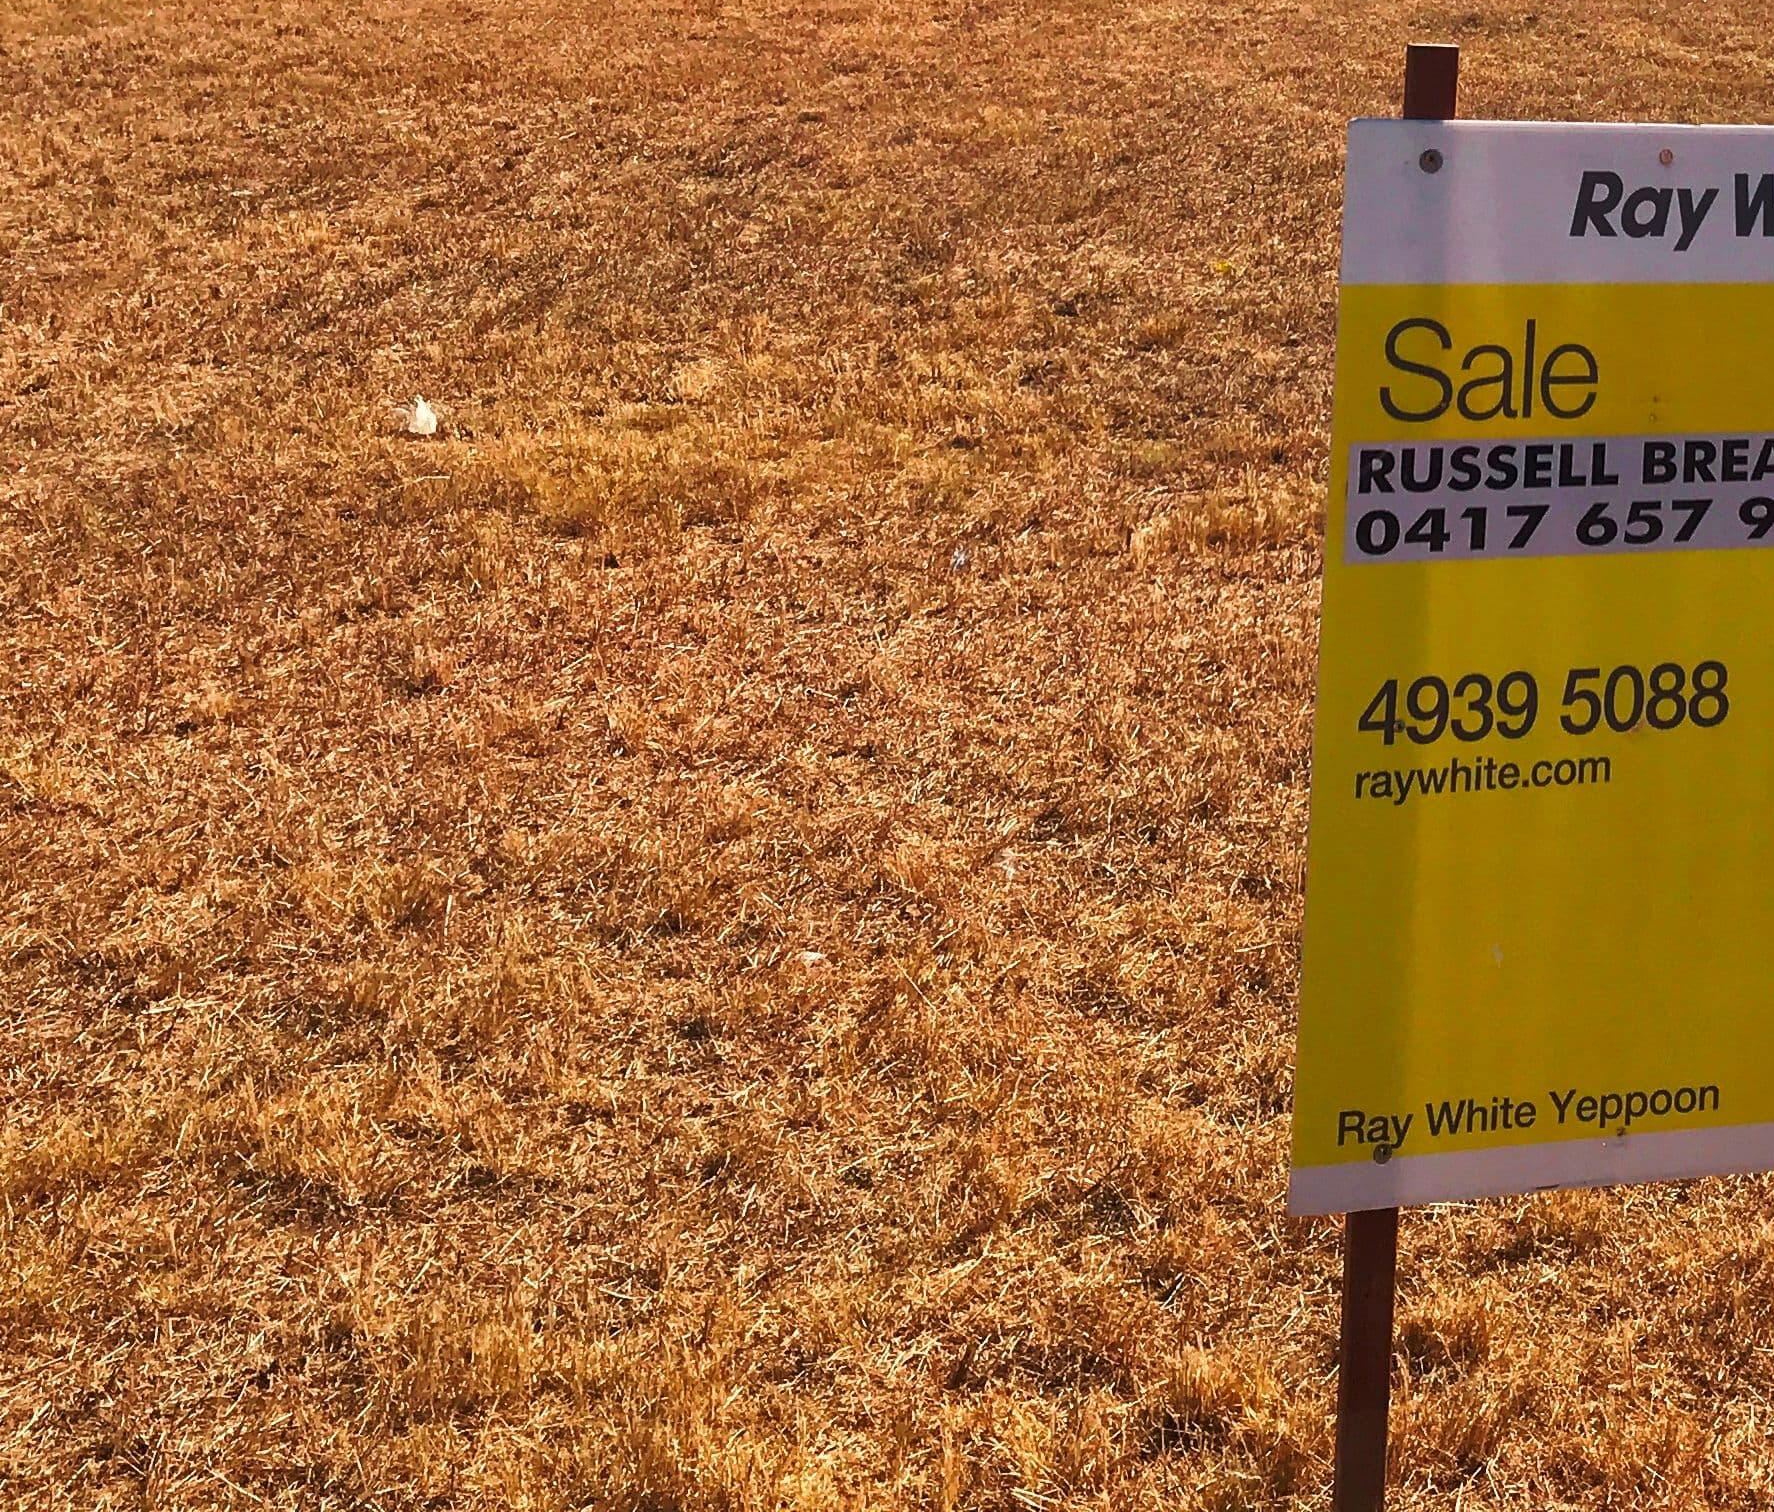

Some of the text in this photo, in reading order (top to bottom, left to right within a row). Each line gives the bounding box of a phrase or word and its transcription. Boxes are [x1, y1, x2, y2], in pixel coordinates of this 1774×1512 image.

[1569, 170, 1719, 252] Ray
[1379, 317, 1599, 423] Sale
[1358, 442, 1619, 494] RUSSELL
[1355, 504, 1550, 556] 0417
[1575, 498, 1713, 546] 657
[1357, 660, 1730, 745] 4939 5088
[1354, 754, 1612, 806] raywhite.com
[1337, 1085, 1720, 1149] Ray White Yeppoon
